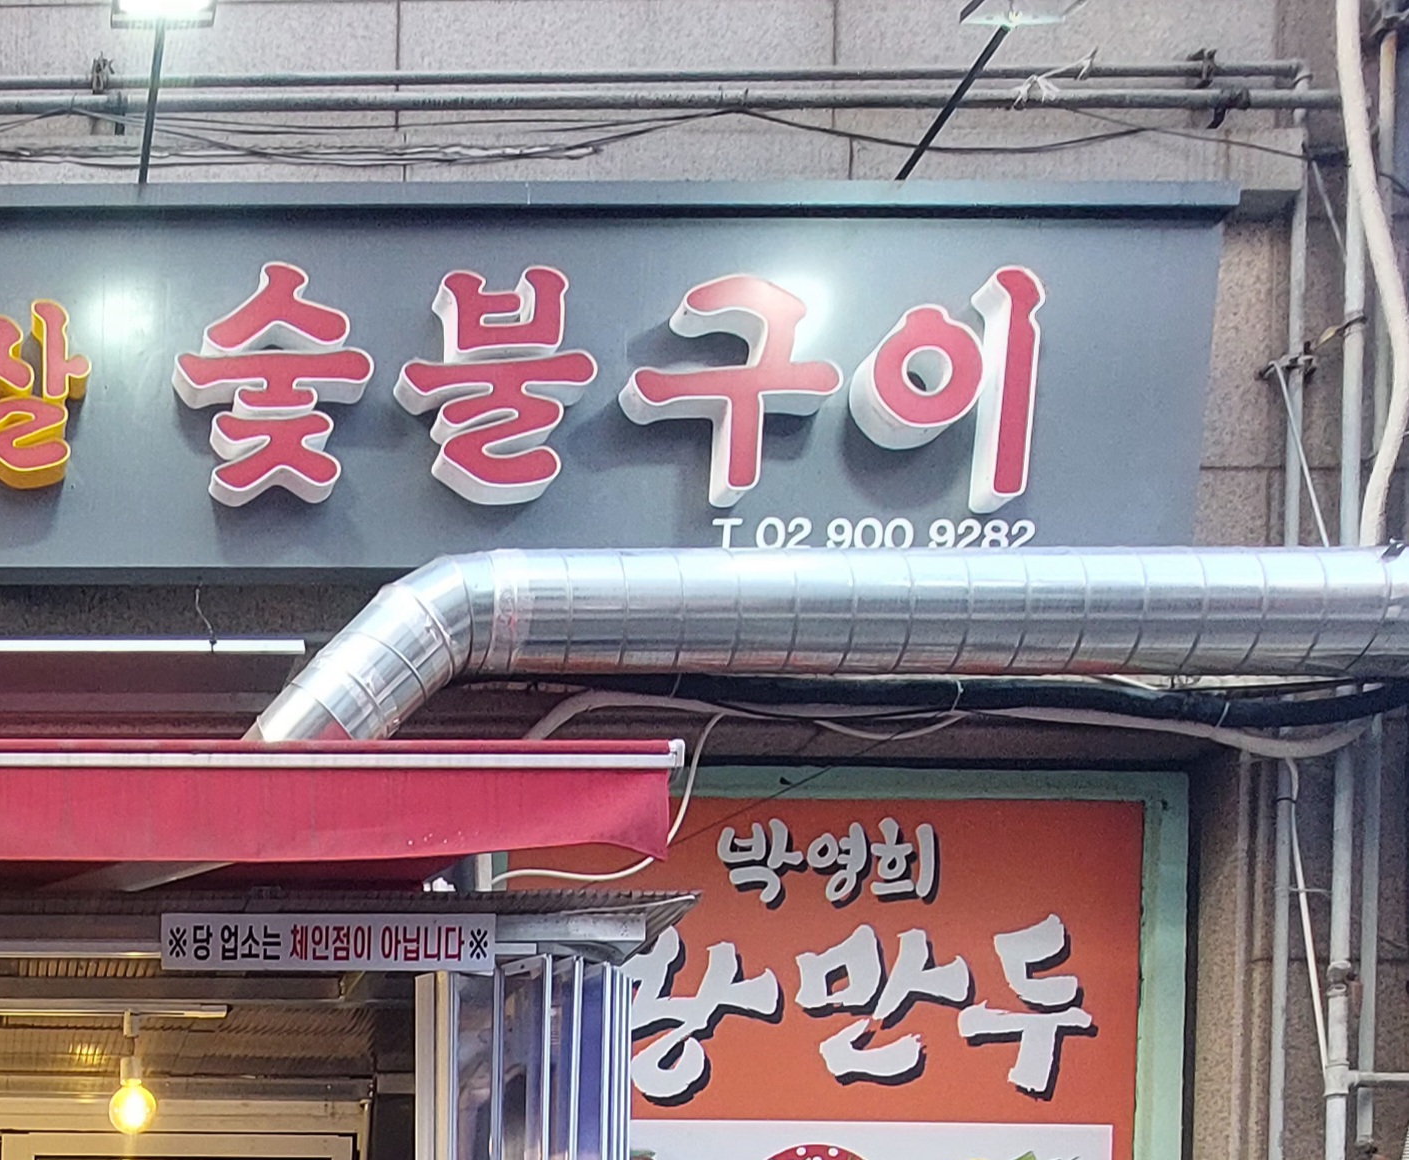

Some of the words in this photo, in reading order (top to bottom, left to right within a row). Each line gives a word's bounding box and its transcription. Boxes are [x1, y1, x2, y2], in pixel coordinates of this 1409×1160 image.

[173, 260, 1045, 512] 숯불구이
[755, 517, 813, 549] 02
[826, 517, 914, 549] 900
[929, 518, 1036, 549] 9282
[717, 816, 937, 906] 박영희
[220, 924, 282, 961] 업소는
[289, 924, 372, 961] 체인점이
